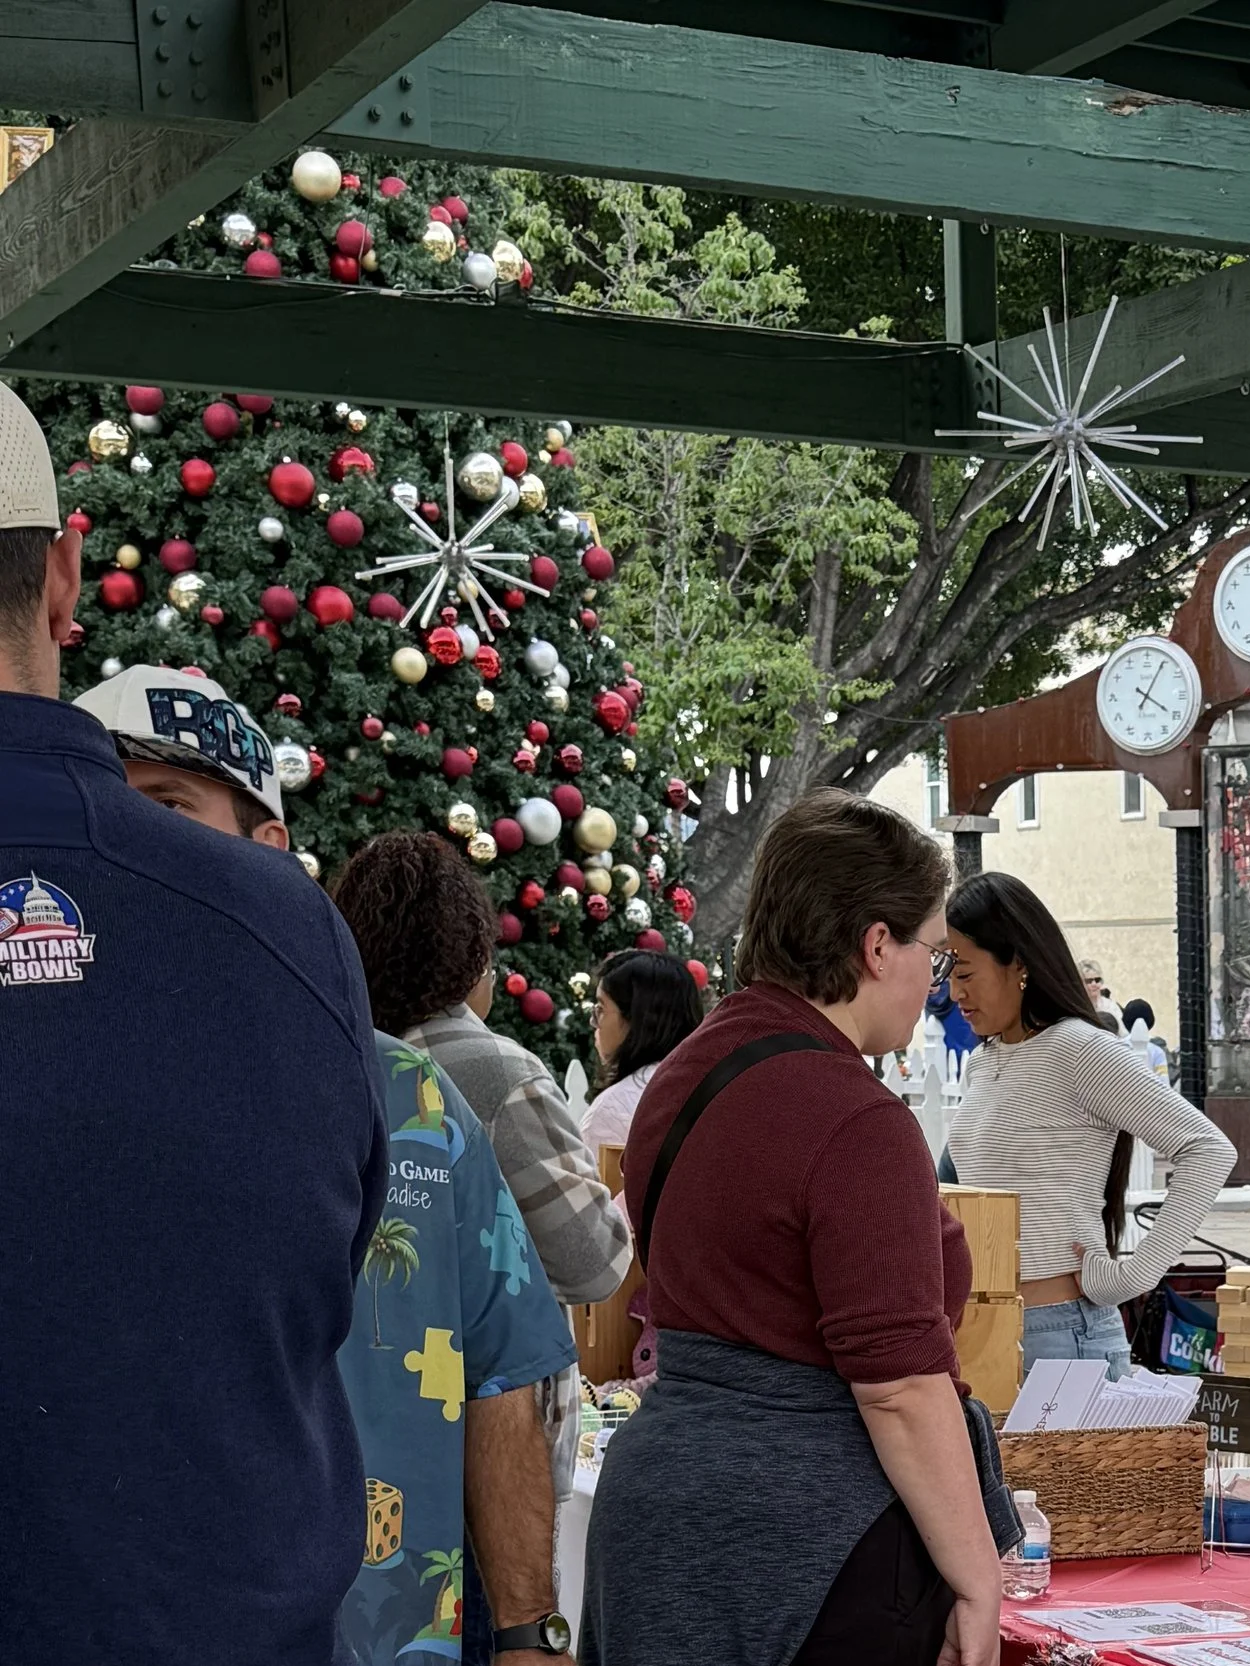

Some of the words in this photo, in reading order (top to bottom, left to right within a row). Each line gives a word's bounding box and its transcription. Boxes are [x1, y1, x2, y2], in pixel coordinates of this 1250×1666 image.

[12, 959, 79, 980] BOWL
[400, 1160, 450, 1184] GAME
[386, 1182, 432, 1210] adise
[1210, 1412, 1220, 1423] TO
[1209, 1425, 1240, 1445] BLE
